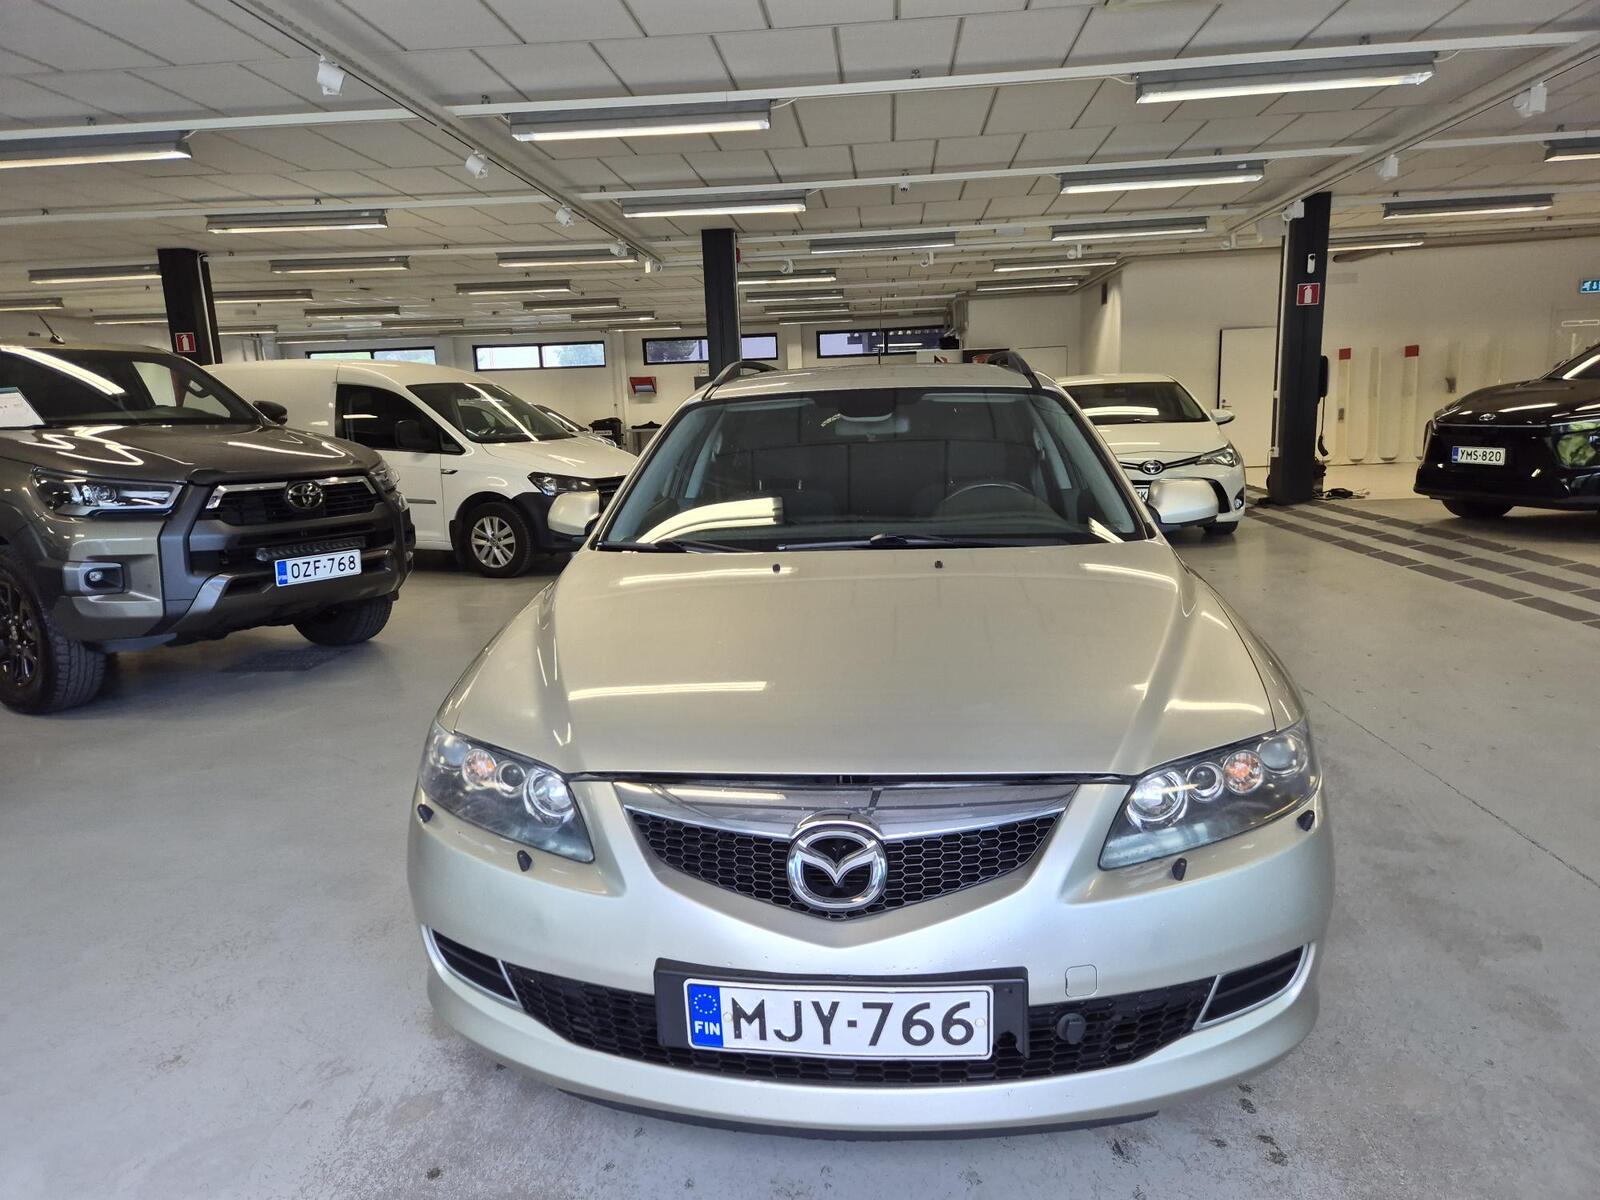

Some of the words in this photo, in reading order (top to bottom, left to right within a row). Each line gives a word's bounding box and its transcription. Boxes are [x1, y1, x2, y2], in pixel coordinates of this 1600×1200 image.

[1460, 449, 1502, 462] YMS-820
[291, 555, 356, 579] OZF-768
[694, 1020, 721, 1036] FIN
[731, 997, 975, 1046] MJY-766
